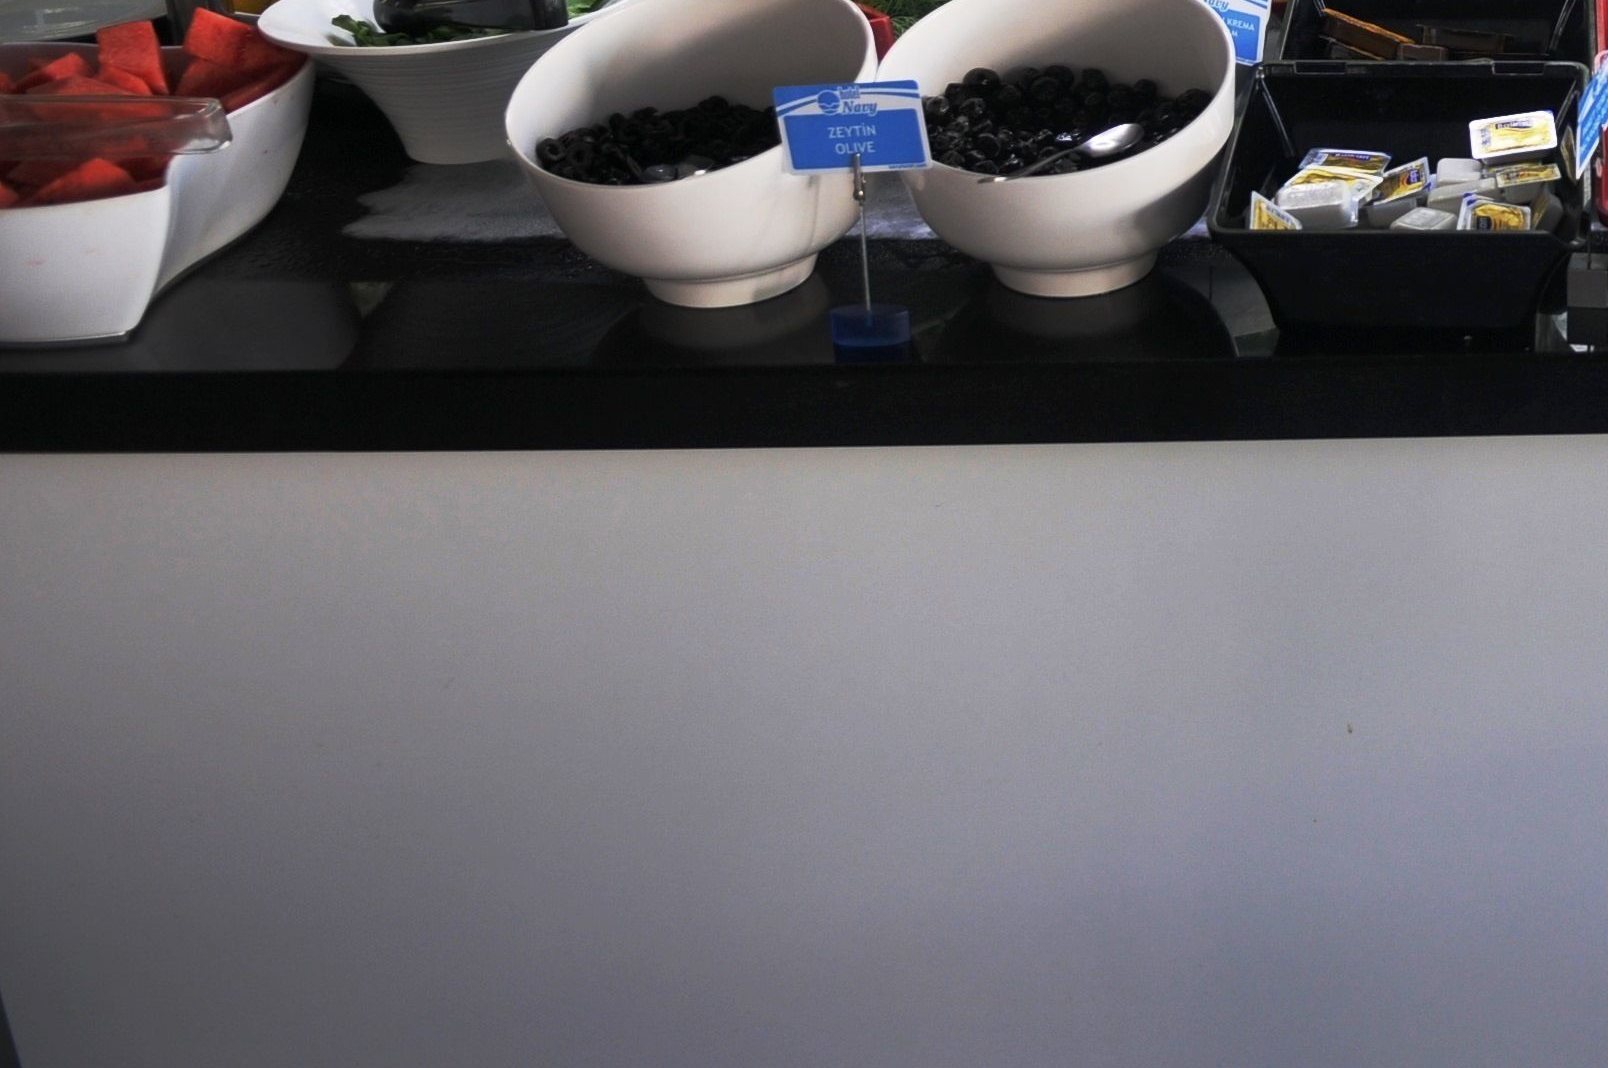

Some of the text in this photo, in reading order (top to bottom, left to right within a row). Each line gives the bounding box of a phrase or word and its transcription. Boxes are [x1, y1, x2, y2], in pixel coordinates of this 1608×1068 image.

[1227, 17, 1255, 31] KREMA
[841, 101, 878, 117] Navy
[827, 122, 877, 139] ZEYTİN
[835, 142, 876, 155] OLIVE
